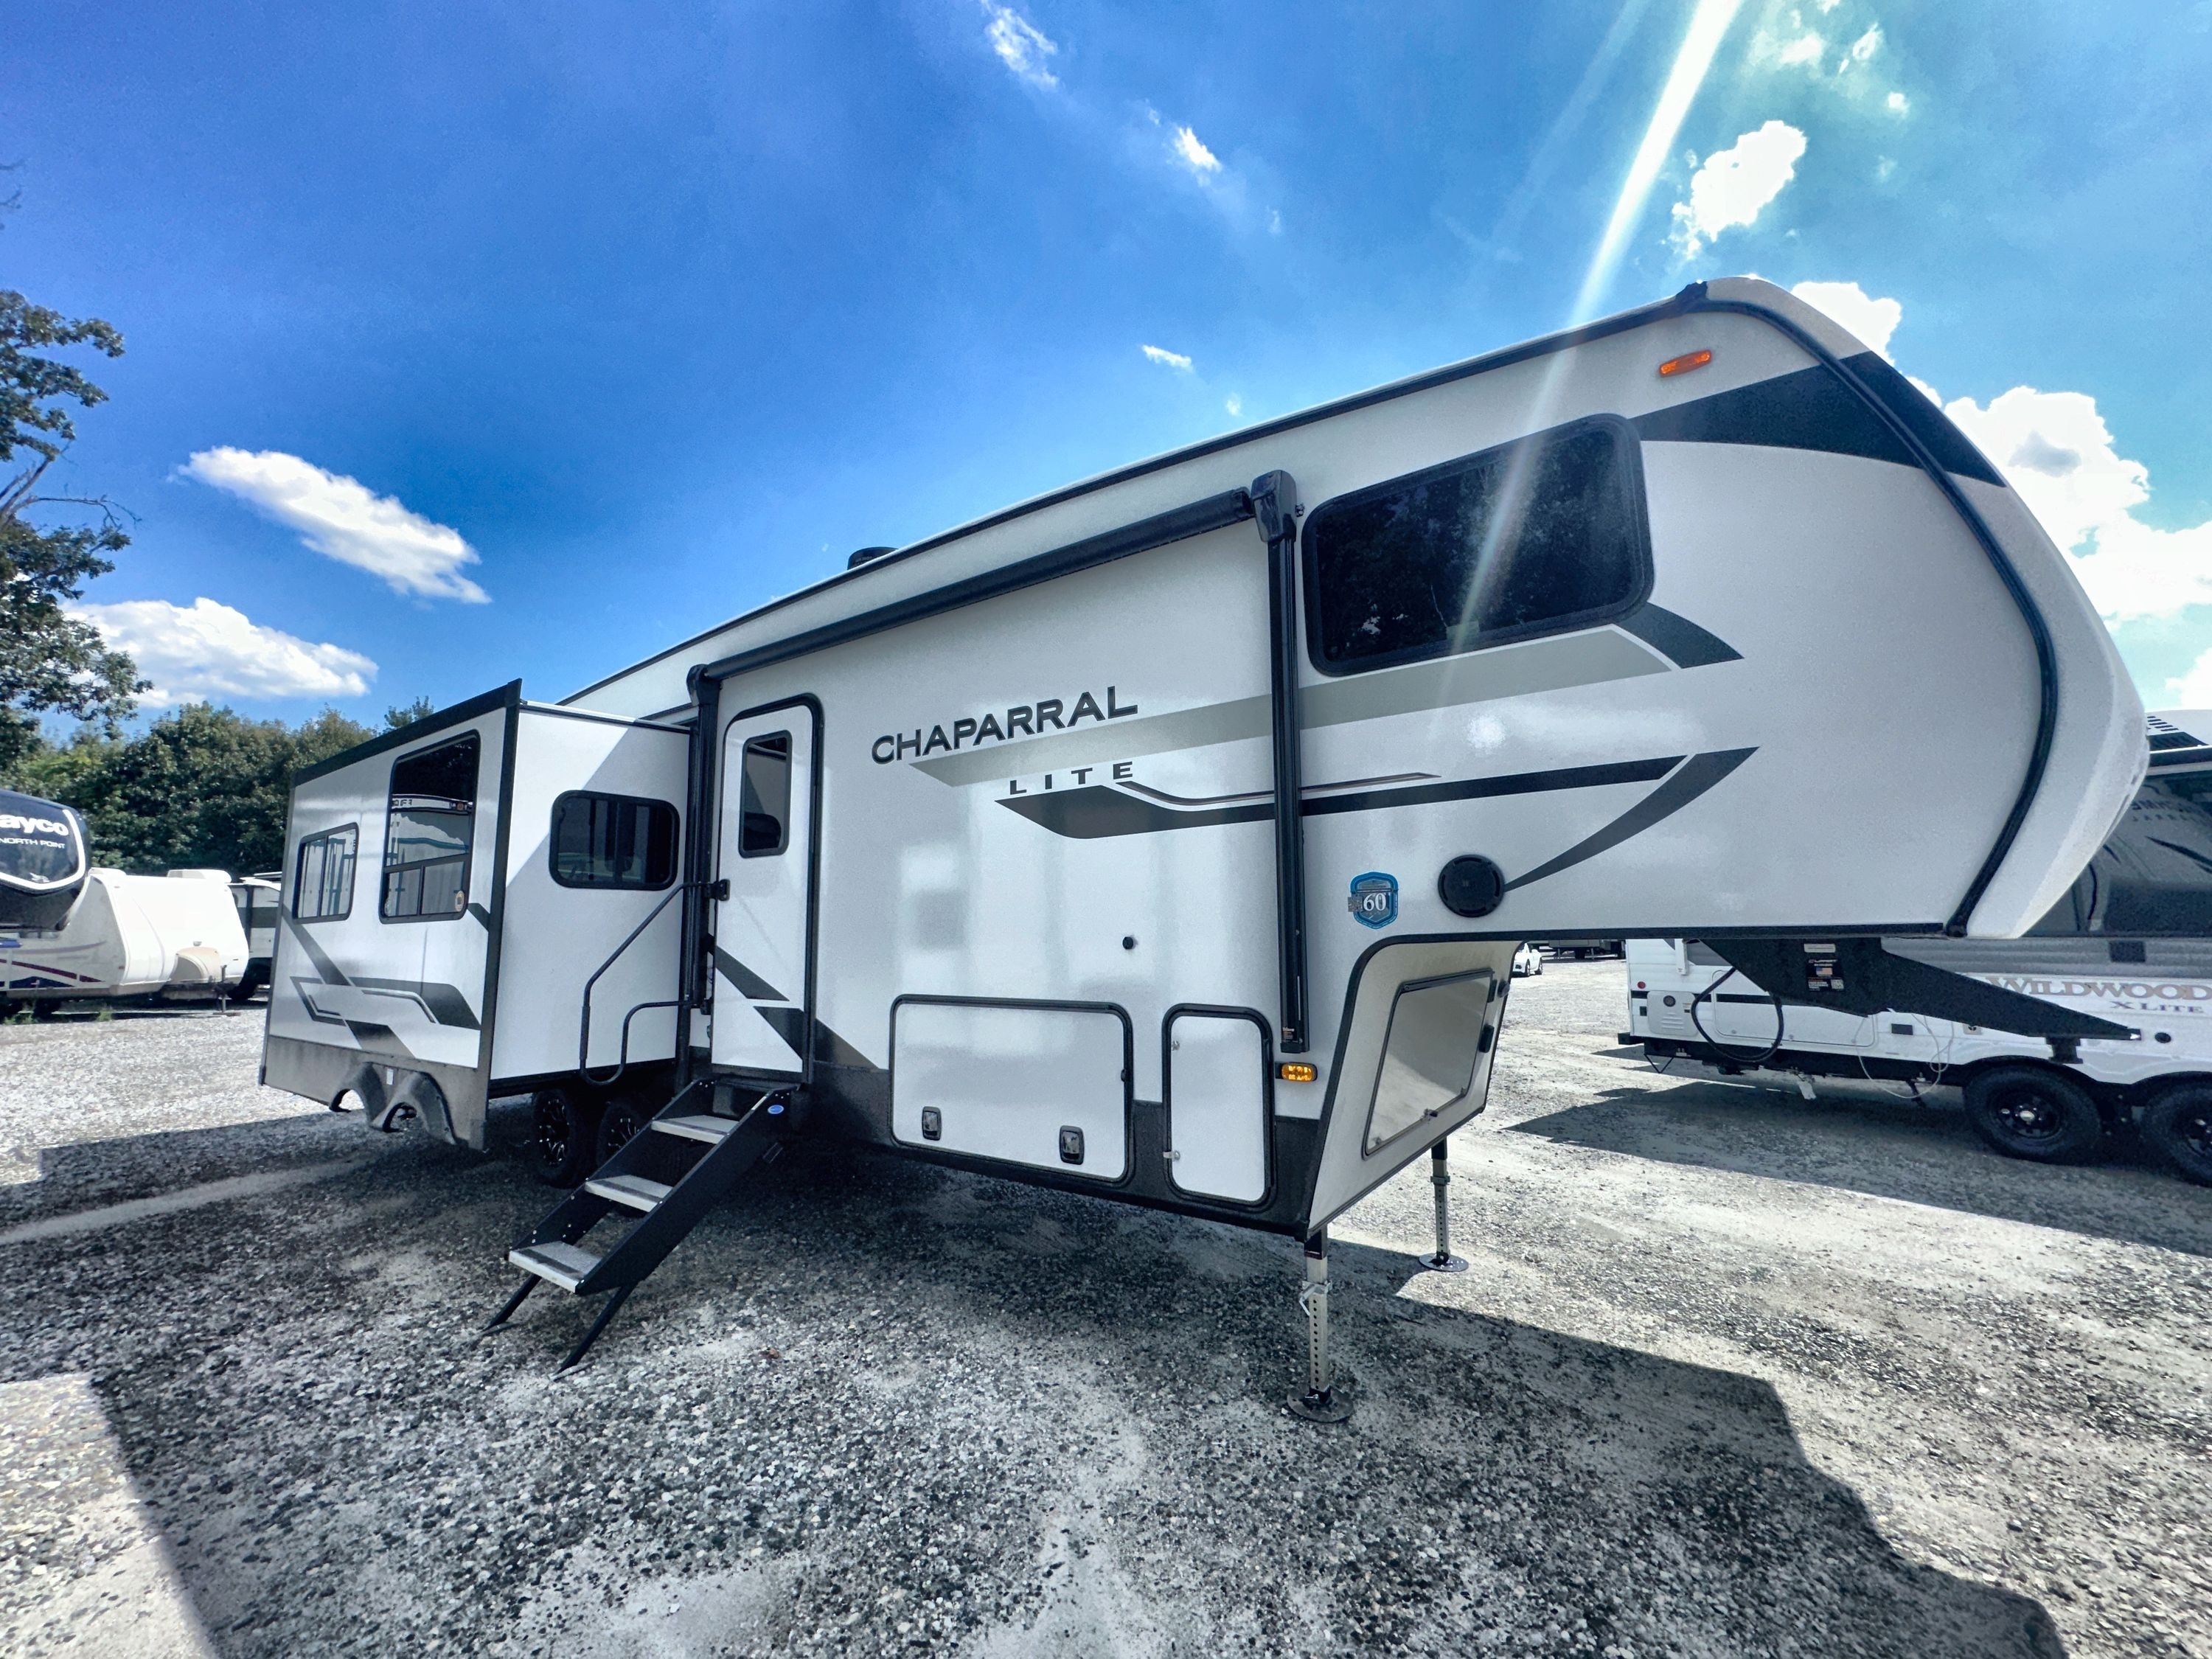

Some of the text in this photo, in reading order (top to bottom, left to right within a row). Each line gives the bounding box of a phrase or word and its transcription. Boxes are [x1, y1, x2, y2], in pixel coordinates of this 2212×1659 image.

[872, 686, 1138, 765] CHAPARRAL
[1009, 762, 1133, 796] LITE
[0, 838, 66, 849] NORTH POINT
[1363, 893, 1387, 911] 60
[1985, 977, 2212, 1001] WILDWOOD
[2109, 1001, 2205, 1014] X LITE
